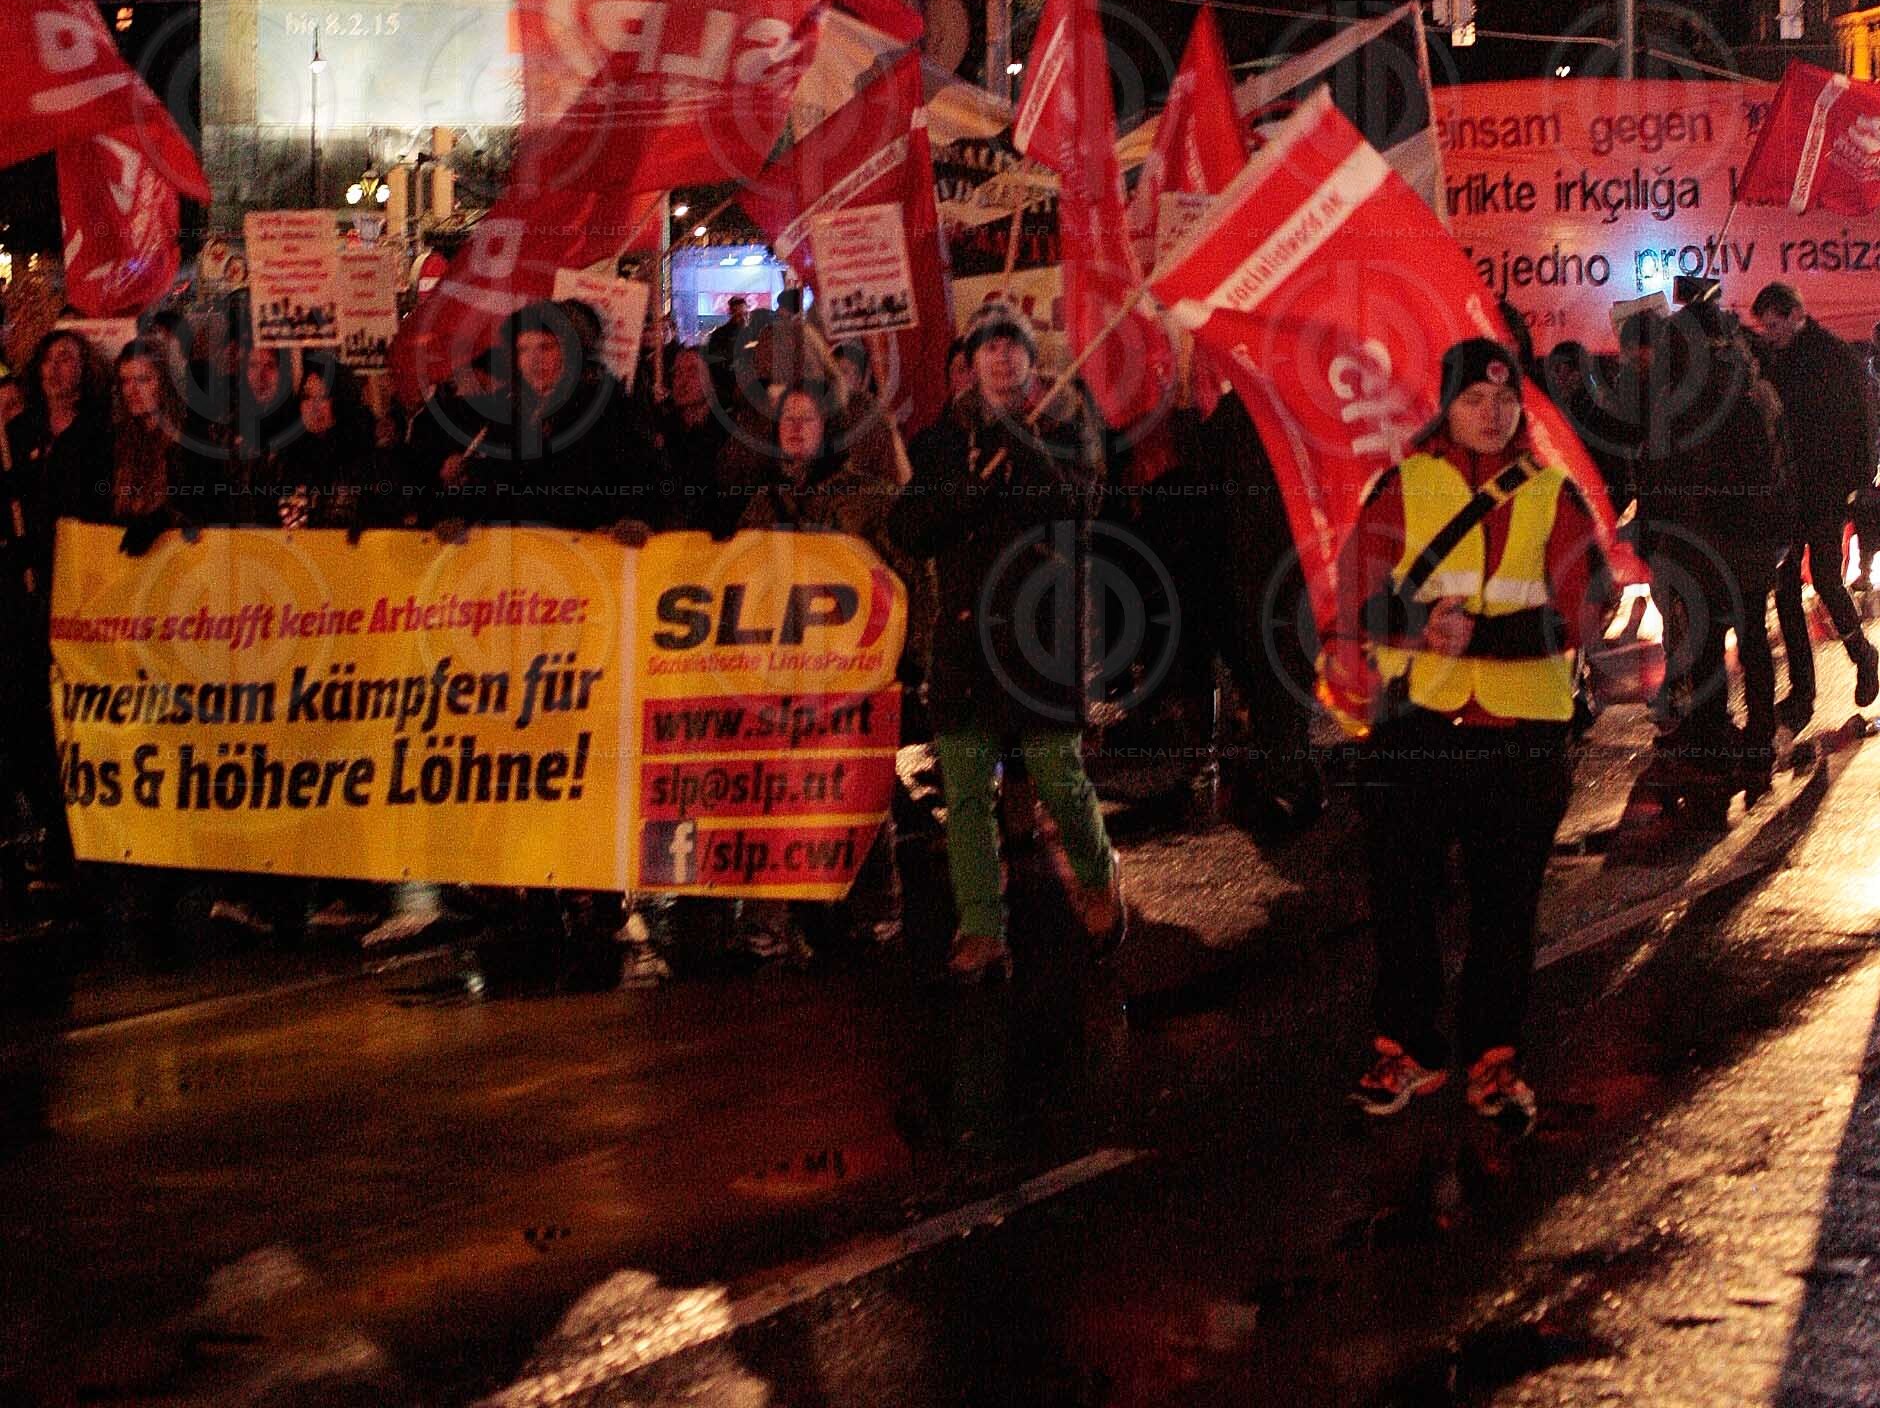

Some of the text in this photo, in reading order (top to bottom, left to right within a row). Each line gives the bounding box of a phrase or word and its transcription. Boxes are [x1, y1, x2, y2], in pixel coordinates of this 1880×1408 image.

[325, 12, 401, 36] 8.2.15
[1591, 110, 1714, 155] gegen
[1464, 245, 1611, 302] ajedno
[1635, 234, 1755, 292] protiv
[159, 603, 275, 650] schafft
[280, 601, 365, 638] keine
[368, 588, 590, 637] Arbeitsplätze:
[653, 584, 859, 651] SLP
[63, 652, 604, 733] meinsam kämpfen für
[654, 696, 875, 750] www.slp.at
[61, 730, 592, 810] bs & höhere Löhne!
[652, 759, 845, 819] slp@slp.at
